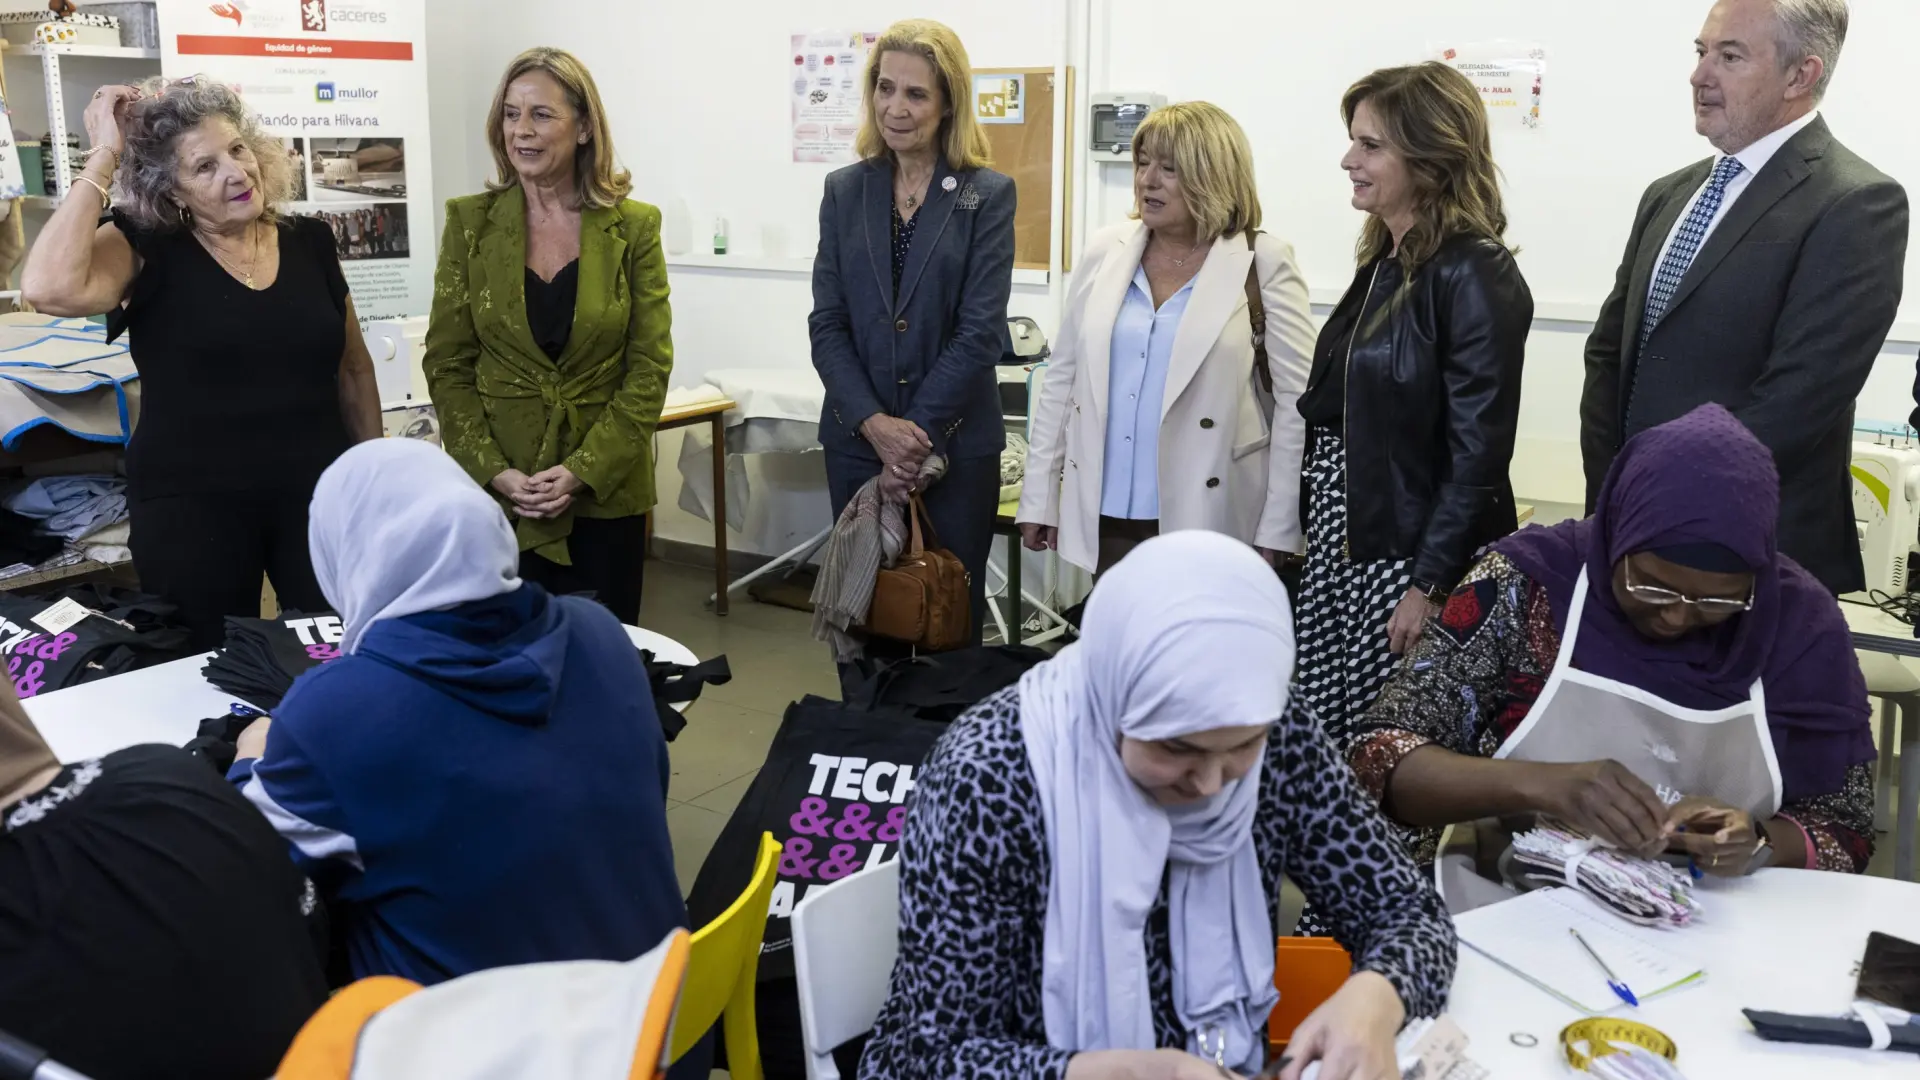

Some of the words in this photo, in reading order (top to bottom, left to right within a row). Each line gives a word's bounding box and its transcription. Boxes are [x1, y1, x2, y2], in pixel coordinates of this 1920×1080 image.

[264, 43, 295, 53] Equidad
[296, 43, 306, 52] de
[338, 87, 379, 99] mullor
[302, 116, 331, 130] para
[334, 113, 380, 126] Hilvana
